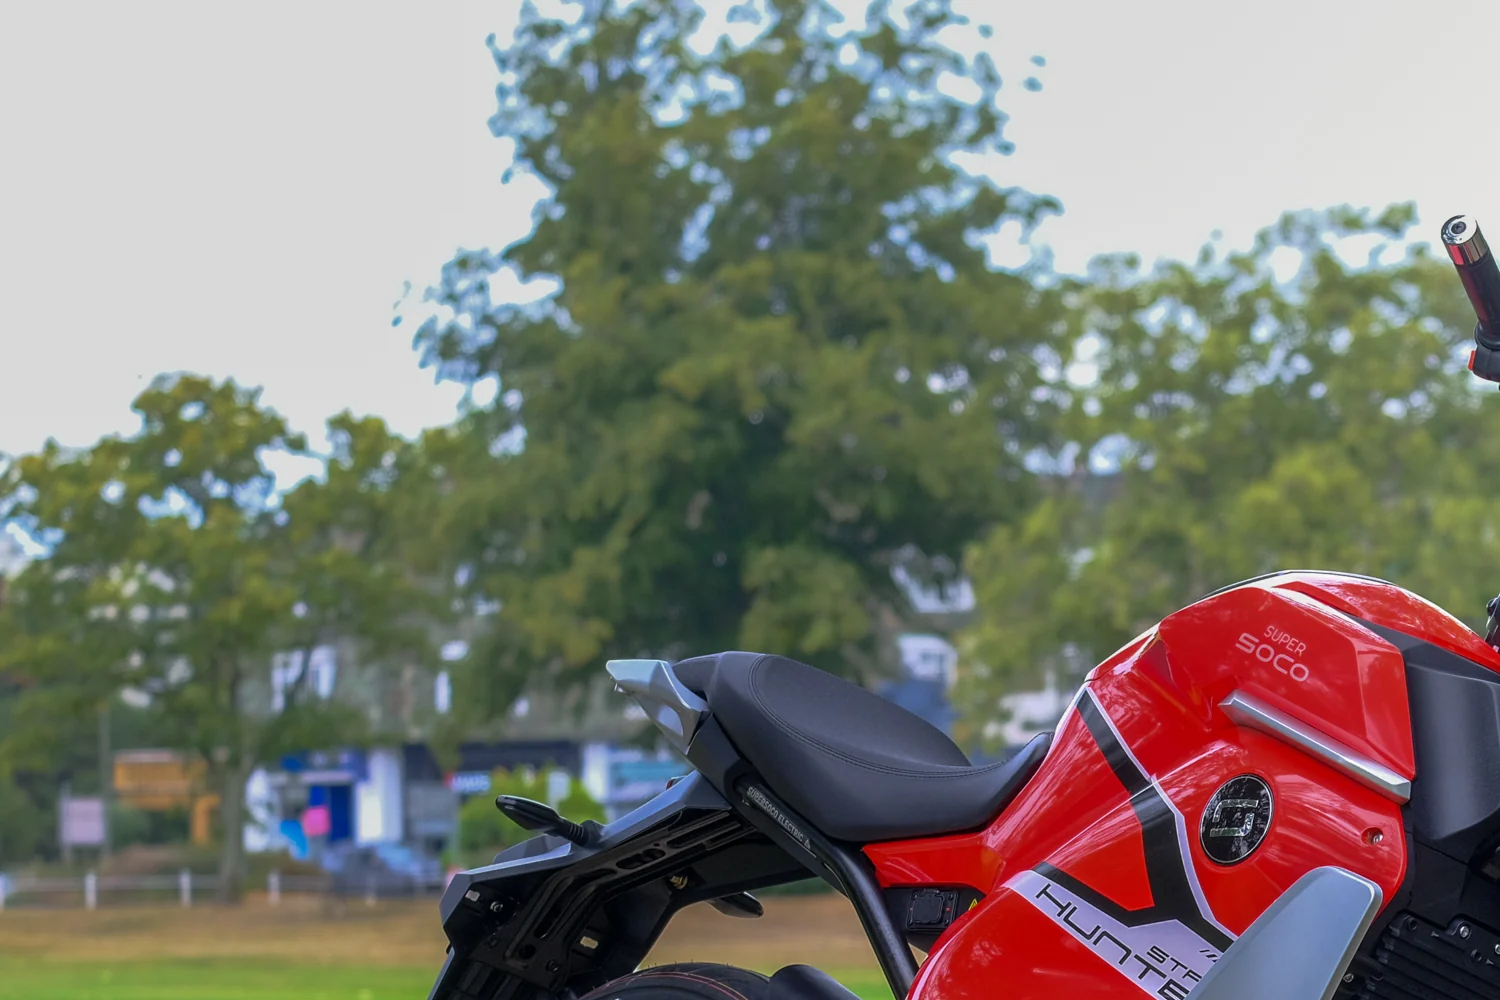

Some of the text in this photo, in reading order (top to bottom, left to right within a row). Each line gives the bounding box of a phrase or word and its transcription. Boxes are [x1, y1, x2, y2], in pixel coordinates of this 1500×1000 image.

[1236, 632, 1310, 683] SOCO
[1263, 624, 1307, 657] SUPER
[1146, 944, 1203, 983] STR
